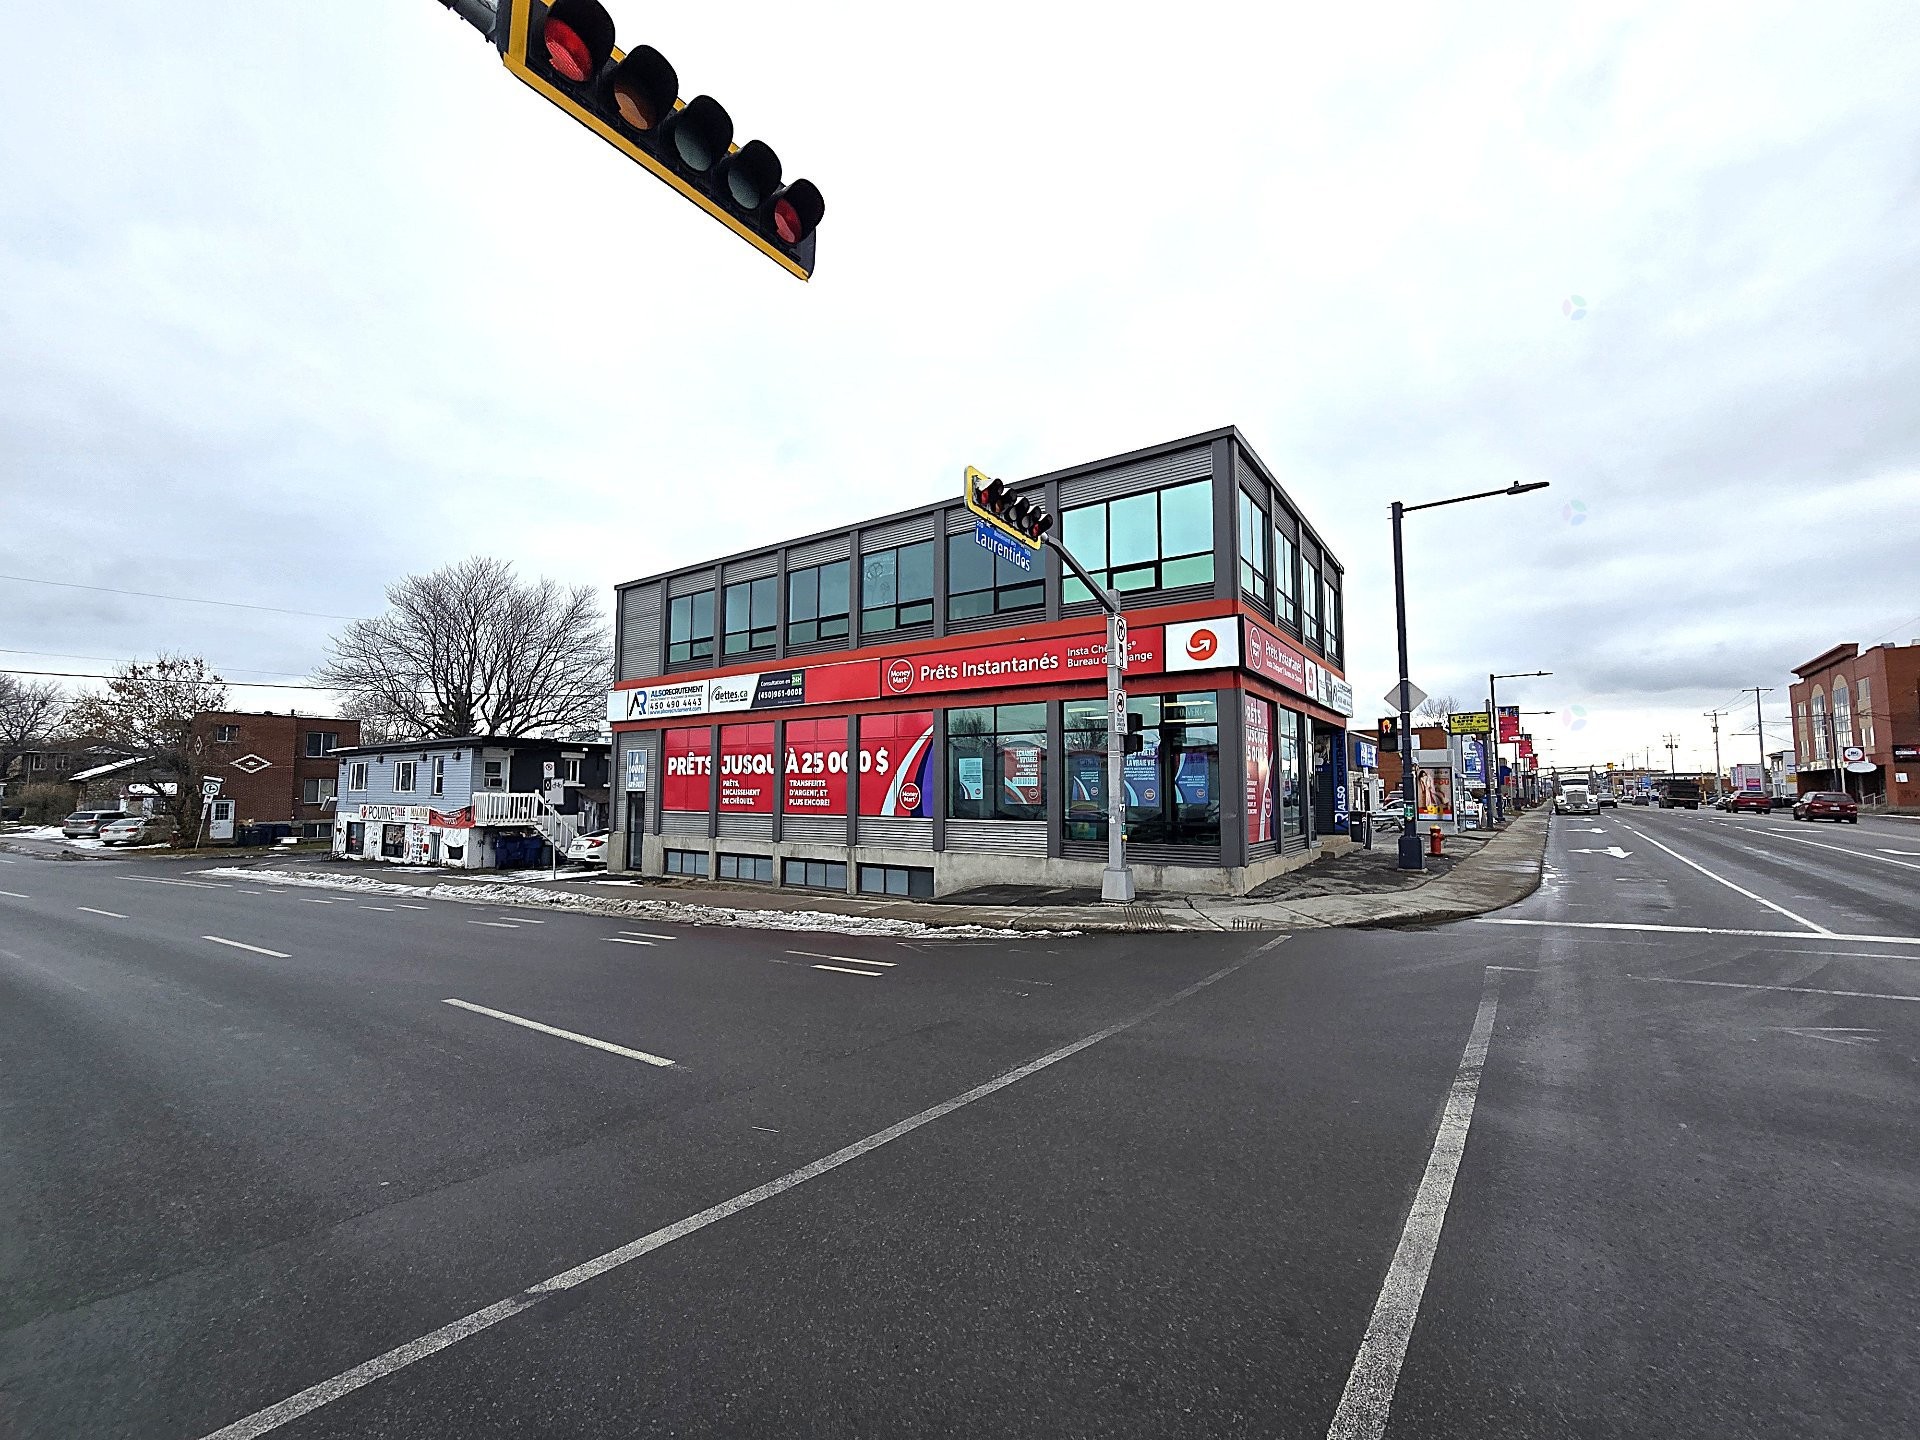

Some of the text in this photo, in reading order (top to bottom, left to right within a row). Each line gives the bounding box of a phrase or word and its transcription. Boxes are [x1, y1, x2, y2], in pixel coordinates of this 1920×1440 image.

[975, 527, 1031, 571] Laurentides
[1067, 646, 1089, 657] Insta
[920, 652, 1058, 681] Prêts Instantanés
[1067, 657, 1099, 668] Bureau
[890, 669, 911, 678] Money
[893, 676, 908, 684] Mart
[715, 690, 748, 701] dettes.ca
[650, 701, 664, 711] 450
[667, 751, 711, 776] PRÊTS
[801, 751, 824, 774] 25
[875, 747, 889, 776] $
[820, 789, 828, 797] ET
[722, 797, 730, 805] DE
[789, 798, 804, 806] PLUS
